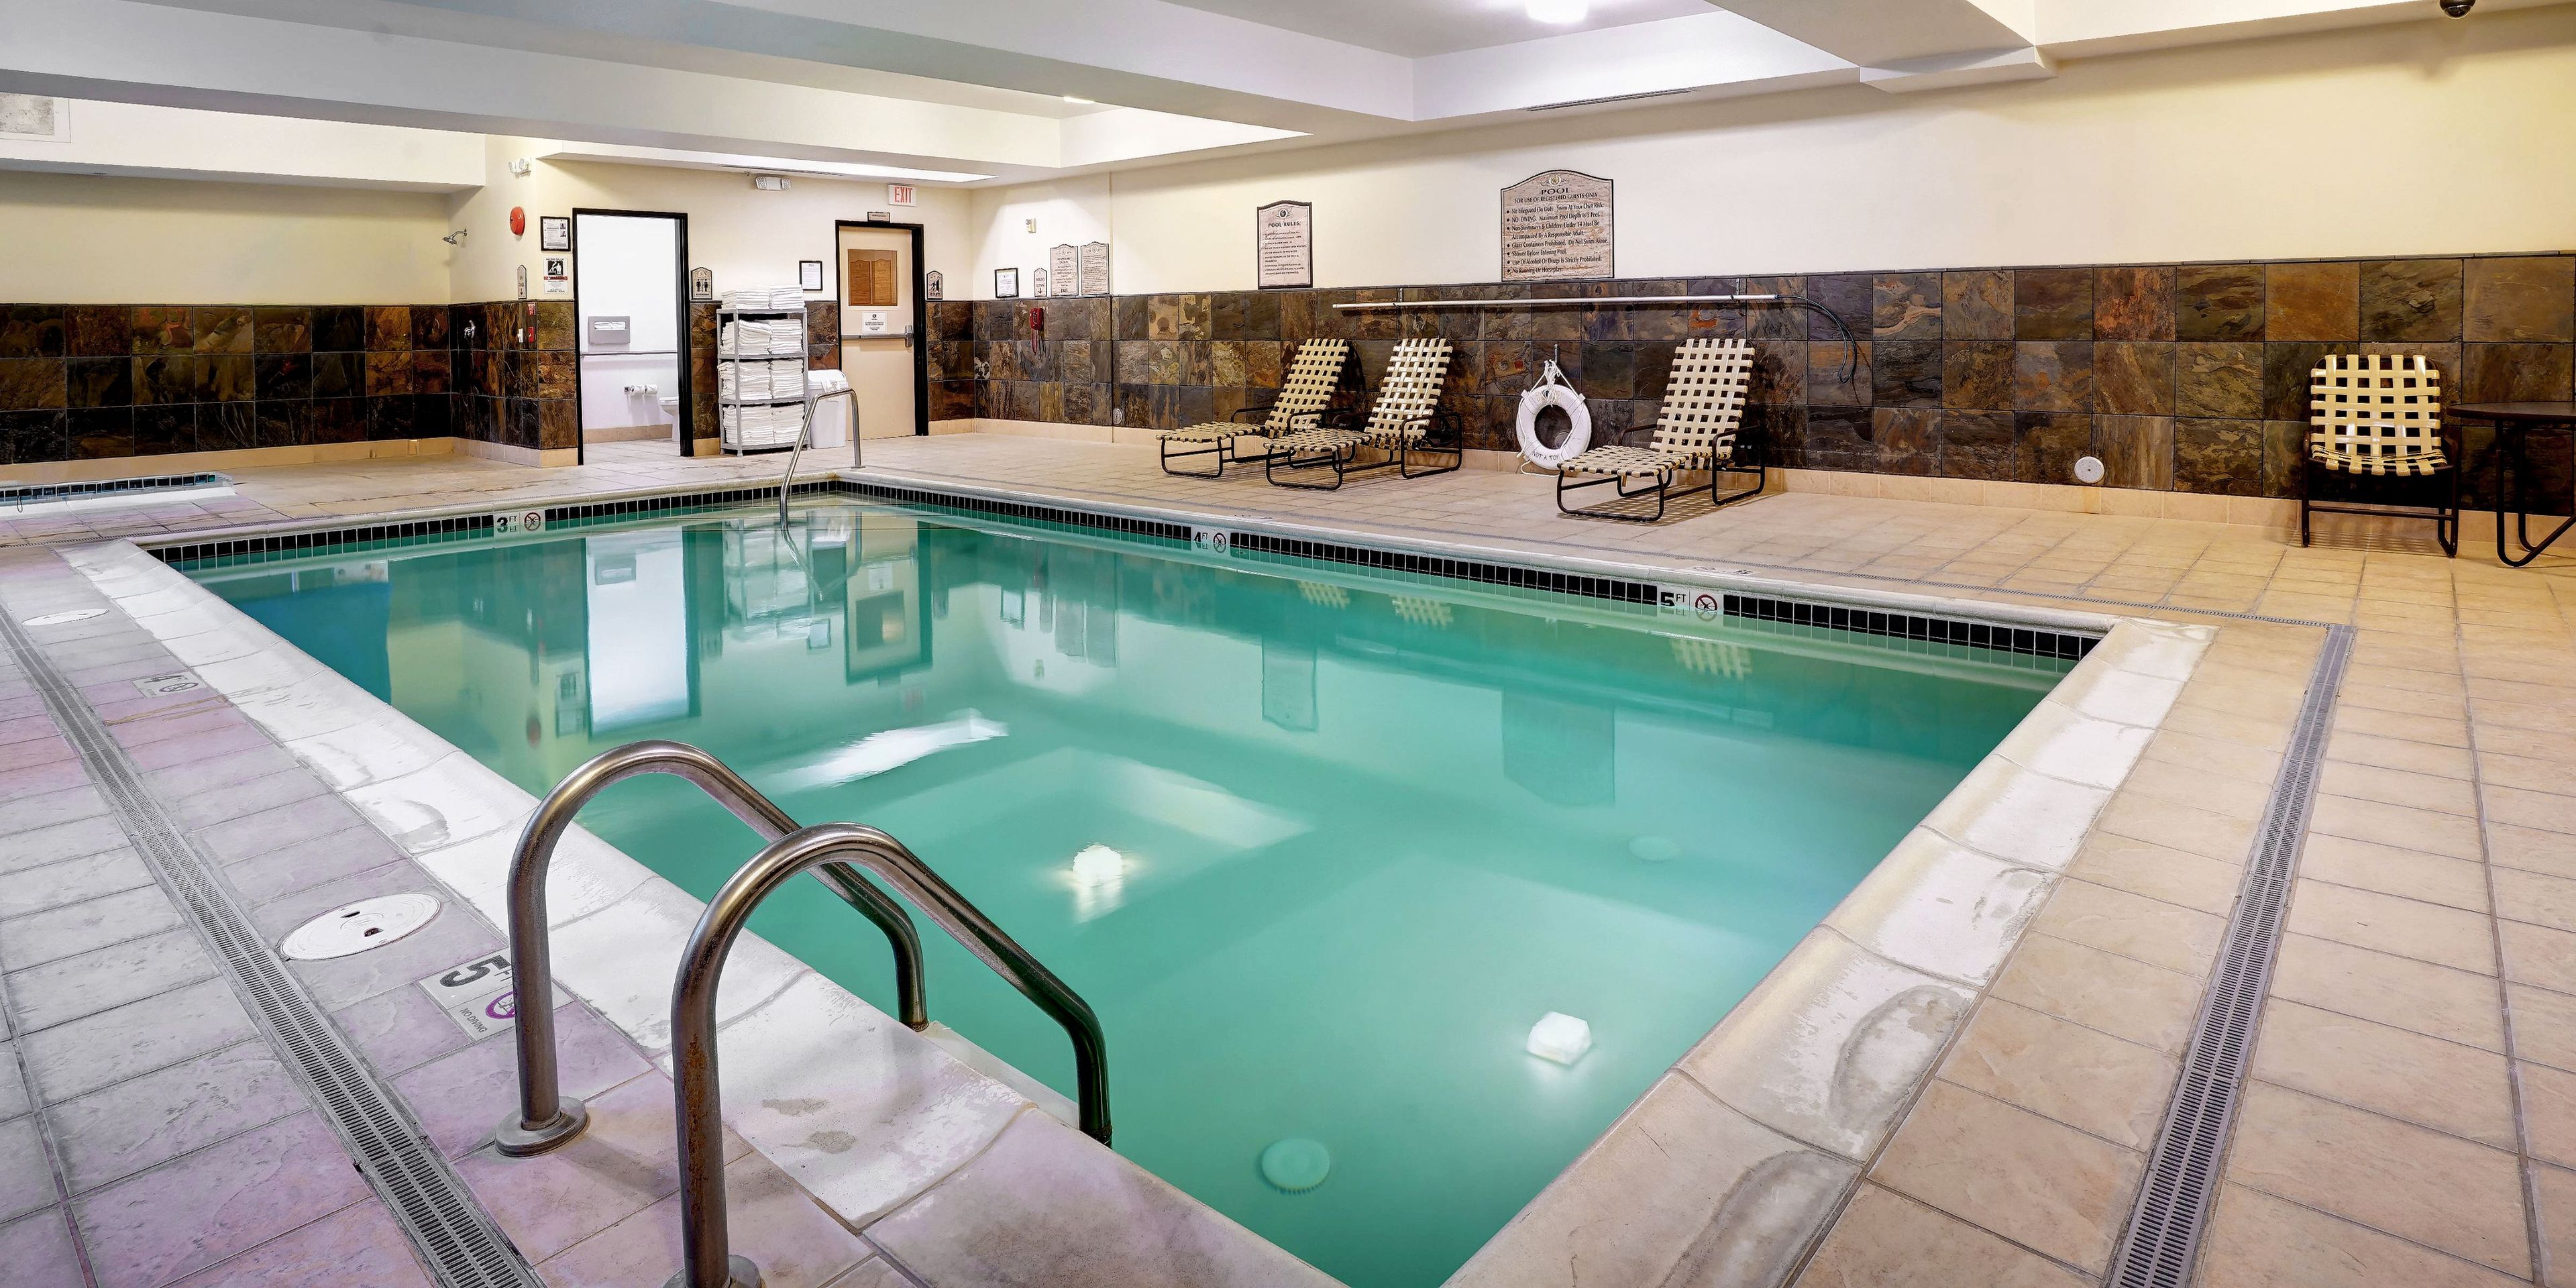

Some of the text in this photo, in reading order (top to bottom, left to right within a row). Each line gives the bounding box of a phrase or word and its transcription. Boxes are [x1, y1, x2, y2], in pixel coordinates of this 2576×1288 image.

[894, 186, 913, 203] EXIT
[1518, 207, 1537, 215] Lifeguard
[1568, 212, 1582, 220] Depth
[1548, 230, 1572, 239] Responsible
[1540, 248, 1557, 256] Entering
[1565, 256, 1579, 264] Strictly
[1532, 451, 1544, 460] NOT
[497, 517, 508, 526] 3
[1193, 532, 1201, 542] 4
[1660, 592, 1686, 606] 5 FT
[439, 955, 512, 987] 5
[460, 1008, 488, 1034] NO DIVING
